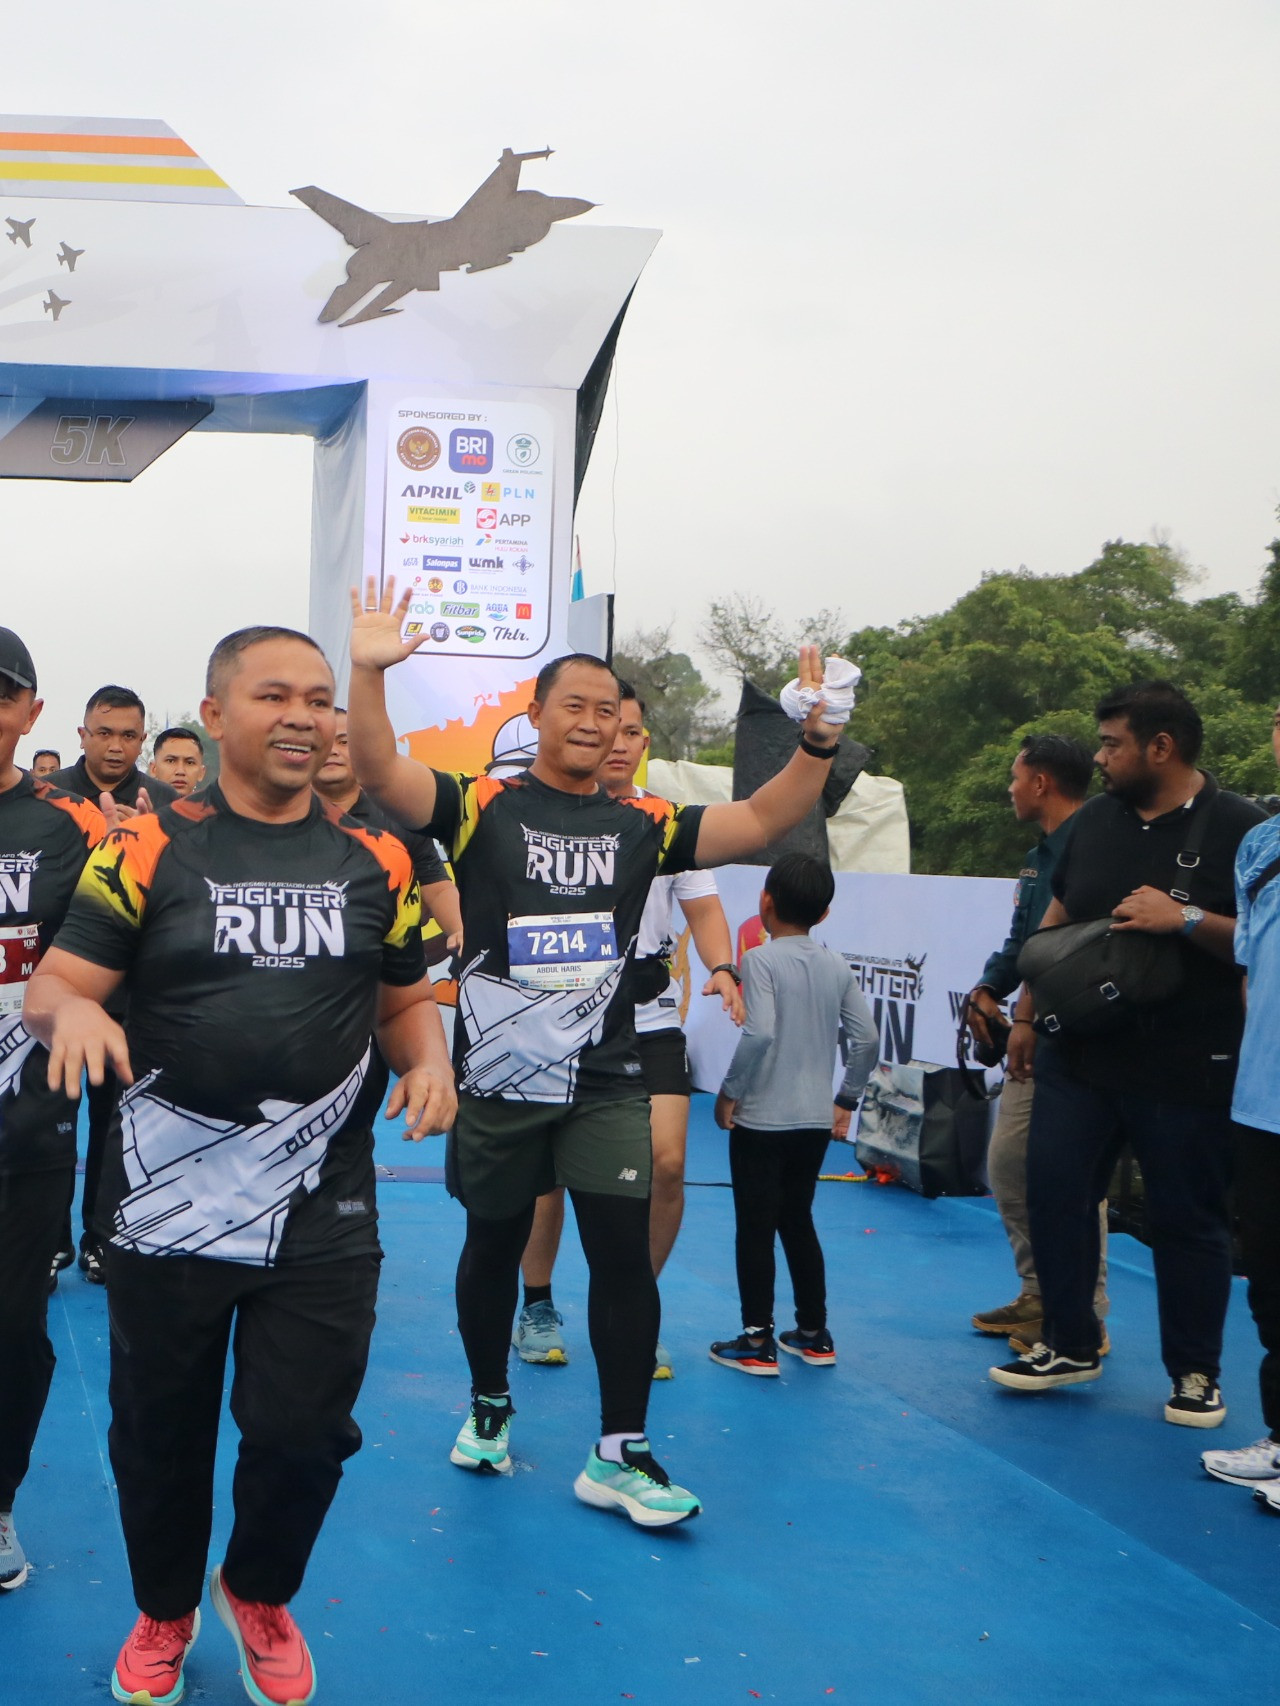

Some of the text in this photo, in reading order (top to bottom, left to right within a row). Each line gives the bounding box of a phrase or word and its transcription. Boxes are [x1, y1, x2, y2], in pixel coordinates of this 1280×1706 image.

[398, 410, 466, 421] SPONSORED
[468, 414, 483, 422] BY
[49, 415, 136, 466] 5K
[456, 436, 488, 455] BRI
[461, 455, 487, 467] mo
[401, 485, 463, 500] APRIL
[409, 507, 457, 516] VITACIMIN
[499, 513, 531, 527] APP
[412, 534, 464, 547] brksyariah
[426, 558, 458, 569] Salonpas
[469, 556, 504, 569] wmk
[470, 584, 527, 593] BANK INDONESIA
[408, 601, 434, 615] rab
[442, 604, 478, 616] Fitbar
[486, 603, 508, 612] AQUA
[456, 629, 485, 638] Sunpride
[528, 832, 616, 852] FIGHTER
[526, 844, 614, 886] RUN
[549, 885, 587, 896] 2025
[216, 887, 342, 908] FIGHTER
[214, 905, 346, 957] RUN
[601, 923, 611, 931] 5K
[22, 938, 37, 948] 10K
[527, 930, 587, 956] 7214
[601, 944, 612, 956] M
[252, 955, 306, 968] 2025
[21, 962, 33, 976] M
[536, 965, 582, 974] ABDUL HARIS
